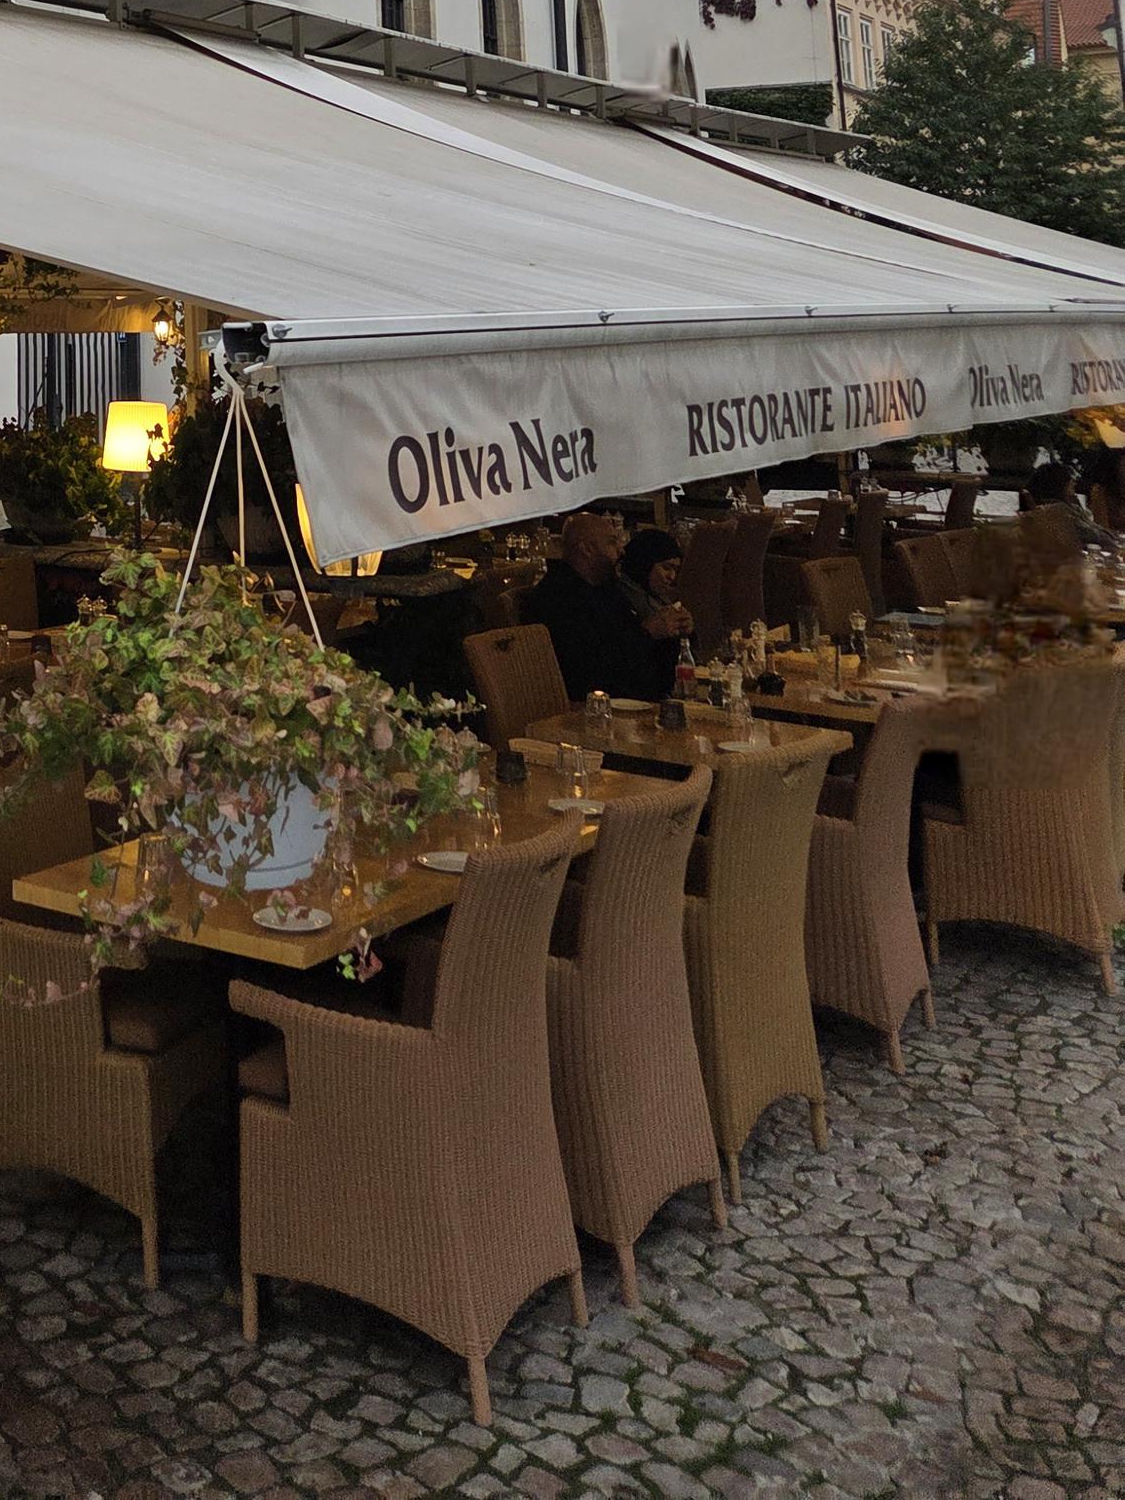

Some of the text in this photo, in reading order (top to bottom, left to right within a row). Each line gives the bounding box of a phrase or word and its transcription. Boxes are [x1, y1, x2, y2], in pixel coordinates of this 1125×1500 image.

[388, 426, 512, 513] Oliva
[509, 418, 598, 490] Nera
[686, 386, 835, 457] RISTORANTE
[844, 377, 927, 430] ITALIANO
